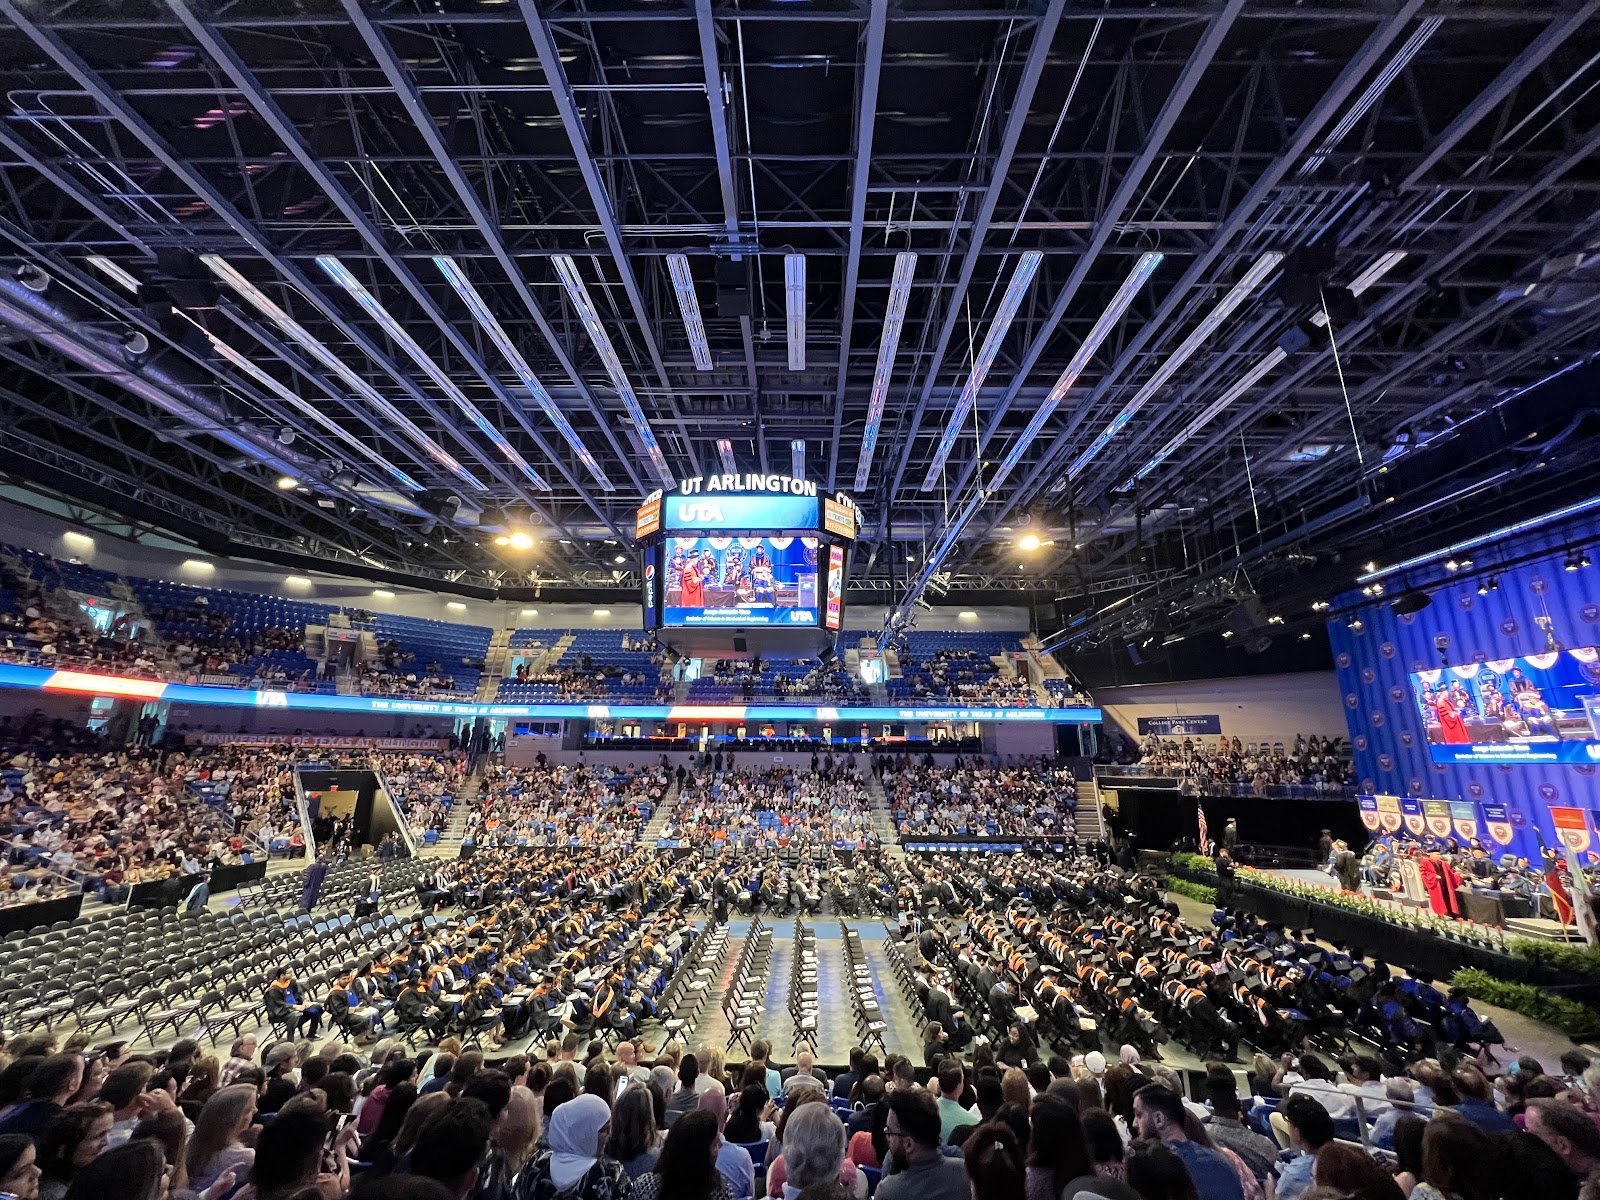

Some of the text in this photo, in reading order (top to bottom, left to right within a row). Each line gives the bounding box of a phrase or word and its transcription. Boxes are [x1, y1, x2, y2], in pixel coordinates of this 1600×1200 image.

[681, 474, 817, 496] UT ARLINGTON
[678, 503, 724, 522] UTA
[790, 610, 814, 621] UTA
[392, 702, 439, 711] UNIVERSITY
[442, 705, 452, 713] OF
[202, 734, 439, 748] UNIVERSITY OF TEXAS AT ARLINGTON
